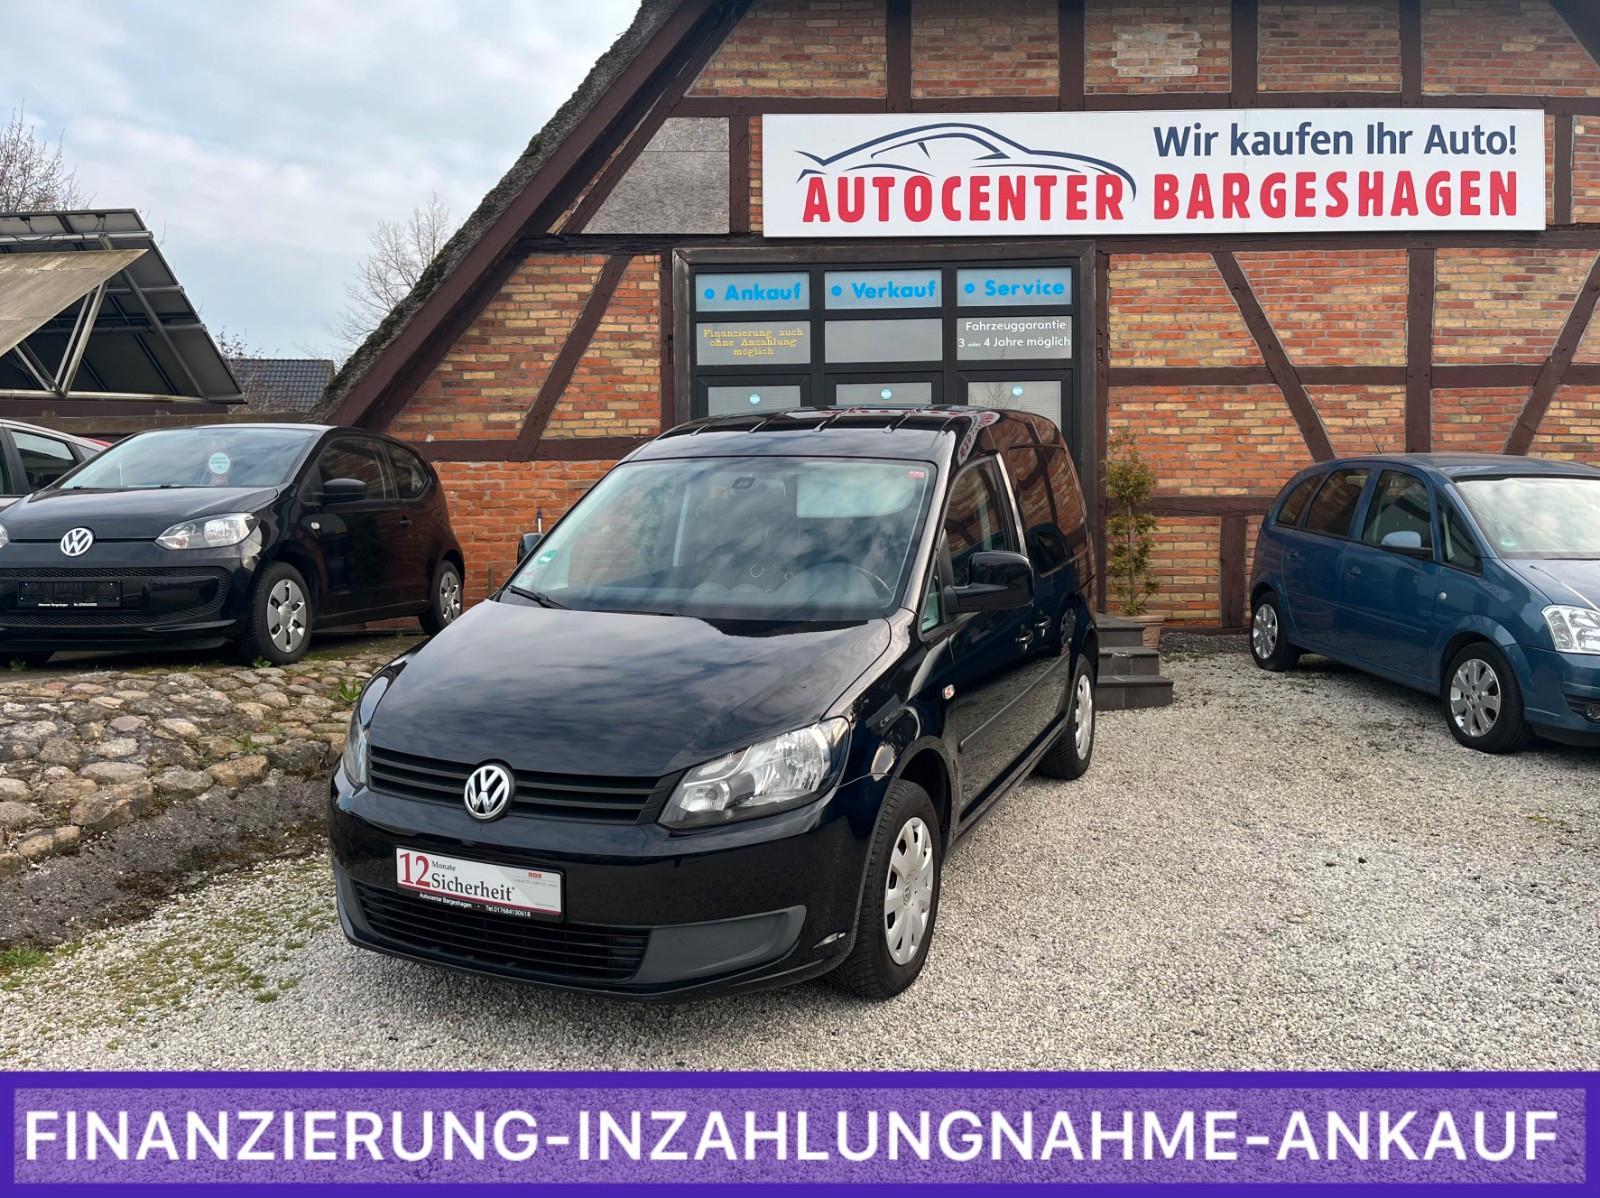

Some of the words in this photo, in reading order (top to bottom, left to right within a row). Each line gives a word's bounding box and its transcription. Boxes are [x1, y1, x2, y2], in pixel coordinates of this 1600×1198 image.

[1154, 122, 1218, 157] Wir
[1230, 121, 1352, 156] kaufen
[1367, 121, 1413, 155] Ihr
[1423, 121, 1517, 155] Auto!
[802, 174, 1125, 223] AUTOCENTER
[1153, 169, 1519, 219] BARGESHAGEN
[725, 282, 801, 301] Ankauf
[851, 280, 936, 299] Verkauf
[984, 279, 1065, 297] Service
[703, 328, 773, 340] Finanzierung
[779, 328, 804, 336] auch
[965, 320, 1067, 333] Fahrzeuggarantie
[711, 339, 735, 347] ohne
[741, 338, 797, 348] Anzahlung
[958, 337, 966, 348] 3
[983, 337, 991, 347] 4
[993, 337, 1024, 347] Jahre
[1026, 335, 1072, 349] möglich
[734, 347, 774, 357] möglich
[399, 852, 431, 888] 12
[431, 860, 457, 872] Monate
